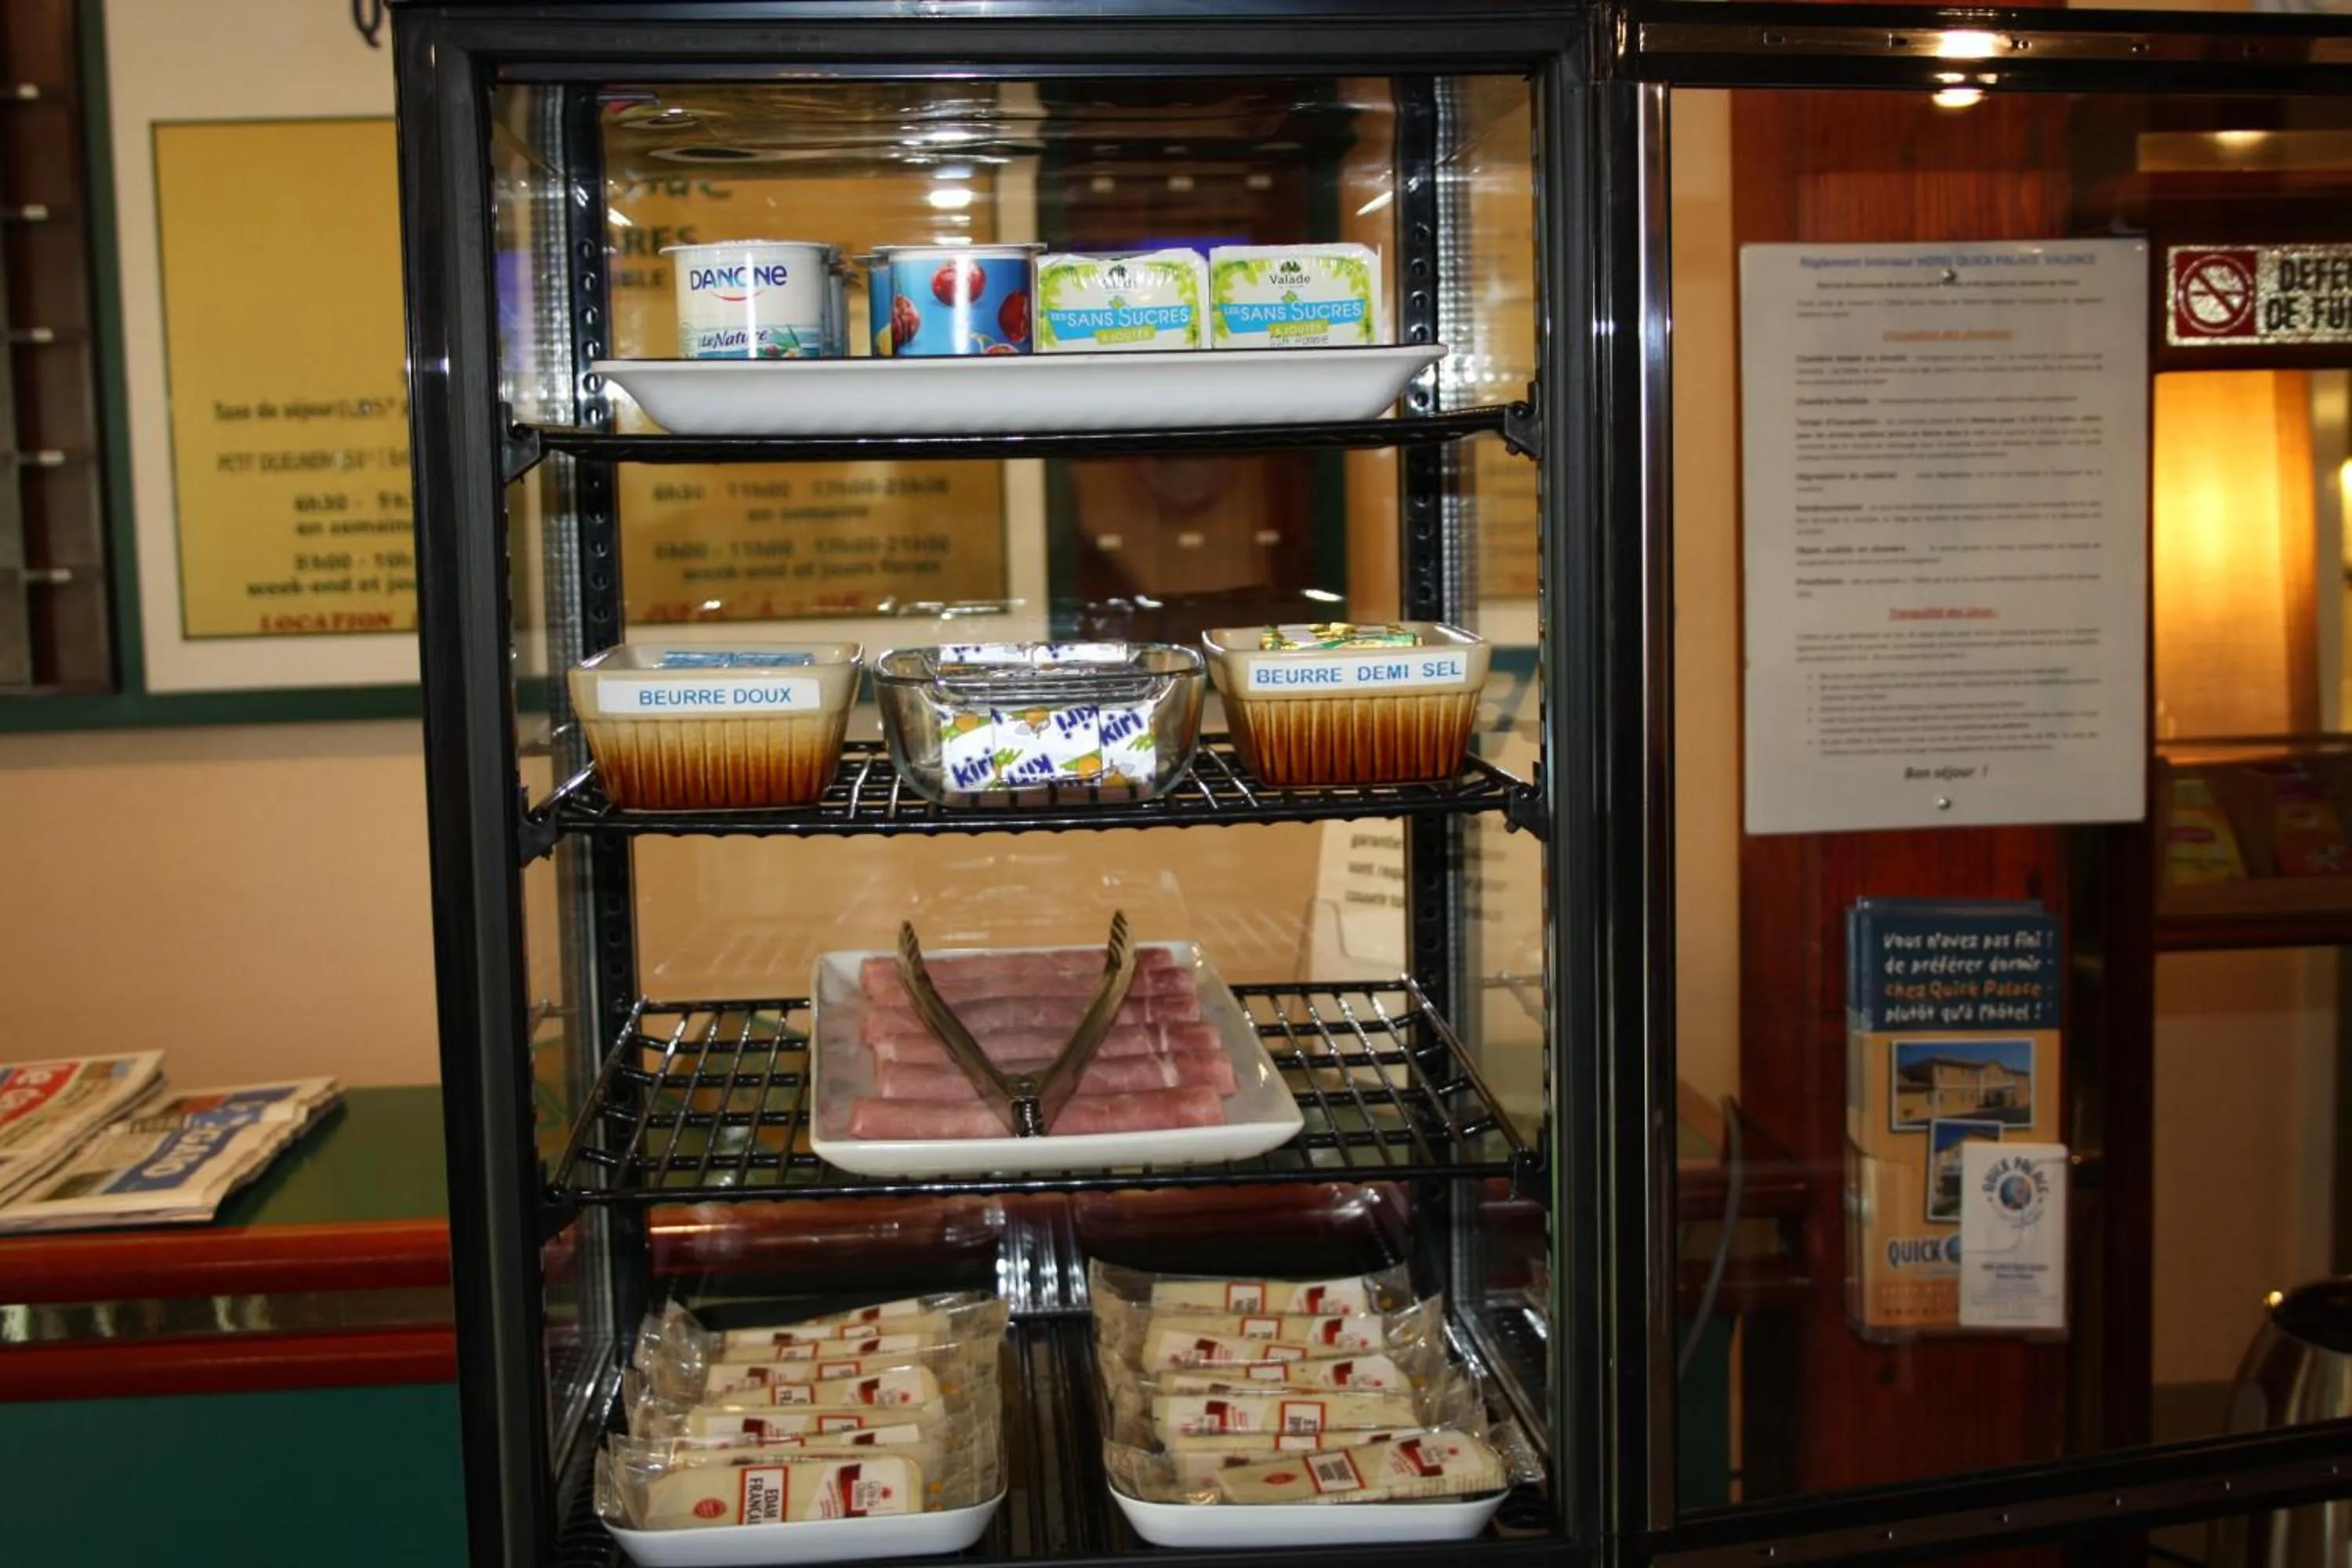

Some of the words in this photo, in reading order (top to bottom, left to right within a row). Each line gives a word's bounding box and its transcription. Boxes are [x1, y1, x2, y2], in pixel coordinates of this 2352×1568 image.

[1269, 274, 1312, 285] Valade
[1067, 310, 1114, 328] SANS
[1241, 304, 1287, 321] SANS
[2266, 296, 2297, 330] DE
[1255, 666, 1343, 684] BEURRE
[1357, 664, 1410, 682] DEMI
[1422, 660, 1463, 678] SEL
[638, 689, 726, 706] BEURRE
[733, 687, 793, 705] DOUX
[1056, 704, 1100, 741] kiri
[1098, 706, 1144, 747] kiri
[950, 746, 996, 789] kiri
[1904, 765, 1931, 779] Bon
[1934, 765, 1976, 781] séjour
[1883, 933, 1922, 950] Vous
[1926, 931, 1978, 950] n'avez
[1982, 934, 2011, 950] pas
[2013, 930, 2042, 949] fini
[1884, 956, 1905, 975] de
[1910, 954, 1984, 975] préférer
[1988, 954, 2042, 974] dormir
[1884, 982, 1926, 999] chez
[1929, 979, 1980, 1000] Quick
[1984, 979, 2043, 998] Palace
[1885, 1004, 1936, 1023] plutôt
[1940, 1003, 1974, 1023] qu'à
[1978, 1002, 2031, 1022] l'hôtel
[1887, 1239, 1943, 1269] QUICK
[746, 1476, 764, 1524] FRANÇAI
[763, 1489, 779, 1519] EDAM
